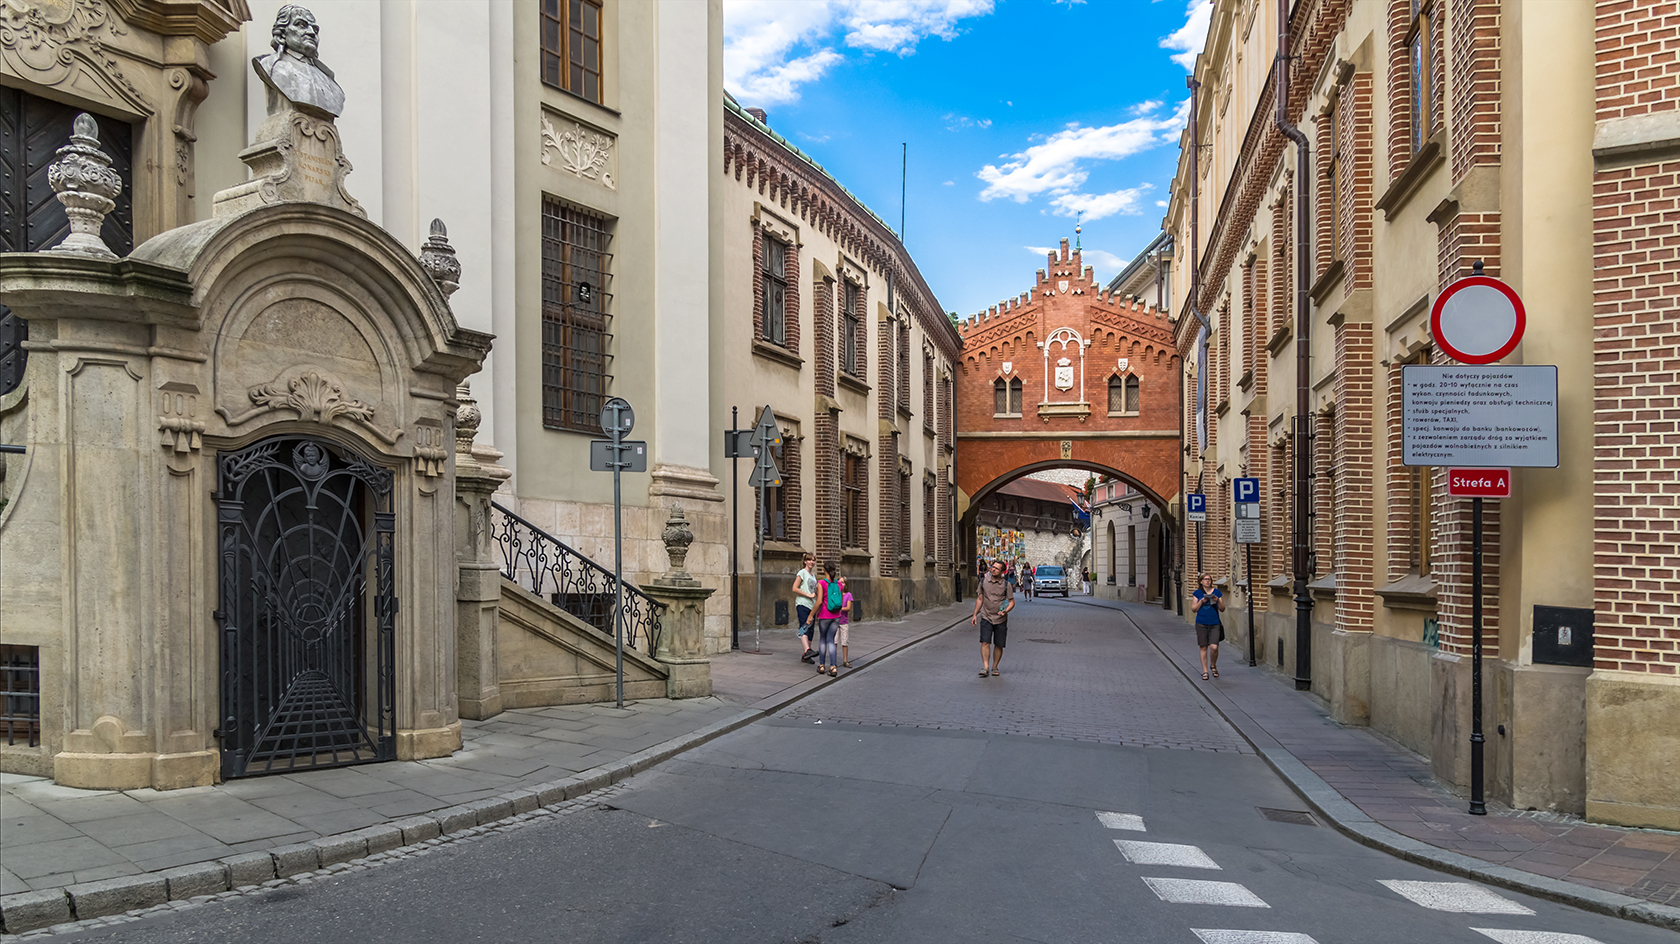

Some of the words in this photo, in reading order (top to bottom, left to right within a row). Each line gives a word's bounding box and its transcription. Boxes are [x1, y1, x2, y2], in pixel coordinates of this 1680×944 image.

[1412, 399, 1438, 407] konwoju
[1489, 399, 1513, 407] obsługi
[1515, 399, 1553, 407] technicznej
[1488, 434, 1503, 442] dróg
[1412, 451, 1454, 459] elektrycznym.
[1453, 477, 1491, 488] Strefa
[1496, 477, 1506, 488] A
[1239, 481, 1254, 500] P
[1191, 496, 1202, 510] P
